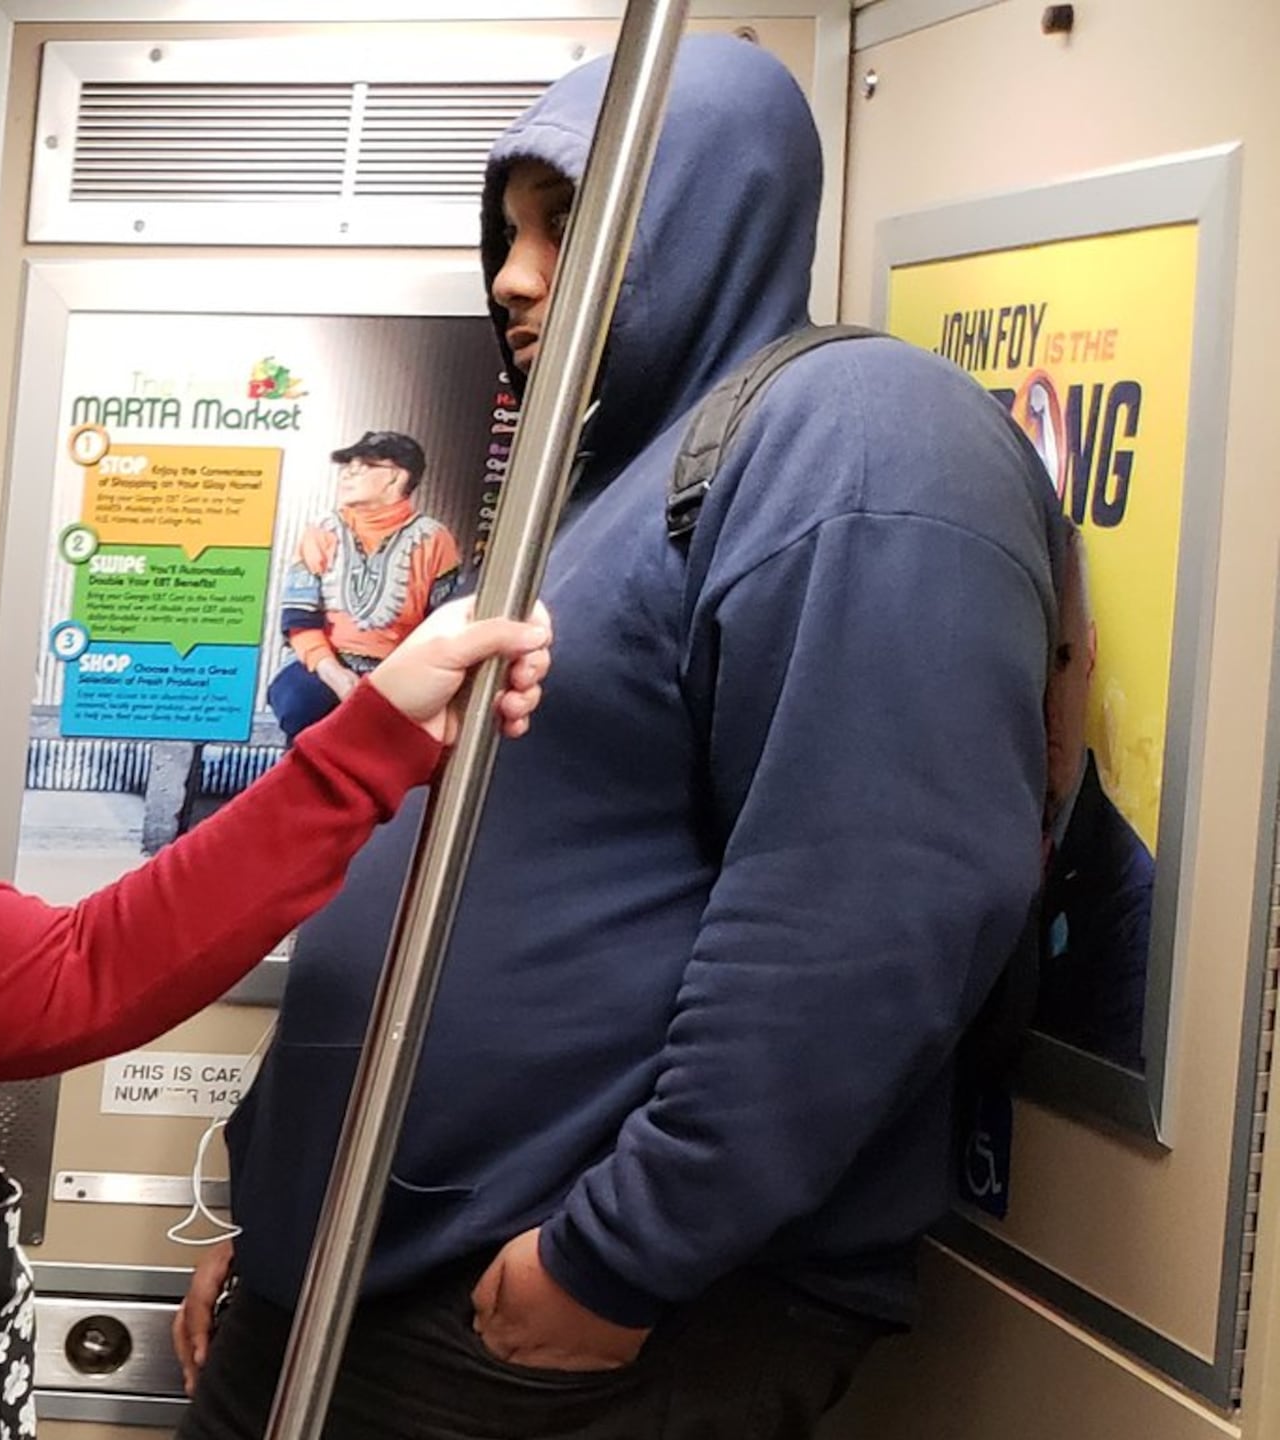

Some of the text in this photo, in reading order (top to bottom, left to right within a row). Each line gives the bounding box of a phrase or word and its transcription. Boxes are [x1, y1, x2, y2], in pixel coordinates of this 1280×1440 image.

[934, 303, 1047, 371] JOHN FOY
[1044, 329, 1118, 363] IS THE
[71, 396, 301, 430] MARTA Market
[98, 455, 263, 479] STOP Enjoy the Convenience
[98, 477, 109, 488] of
[111, 478, 158, 490] Shopping
[178, 479, 200, 489] Your
[202, 480, 226, 491] Way
[73, 535, 84, 552] 2
[89, 555, 147, 575] SWIPE
[178, 565, 245, 579] Automatically
[89, 576, 124, 587] Double
[128, 577, 150, 587] Your
[153, 578, 172, 588] EBT
[64, 632, 75, 649] 3
[78, 653, 132, 674] SHOP
[133, 664, 170, 675] Choose
[173, 664, 196, 675] from
[208, 665, 239, 676] Great
[77, 674, 210, 688] Selection of Fresh Produce!
[173, 1066, 192, 1082] IS
[208, 1089, 241, 1106] 143
